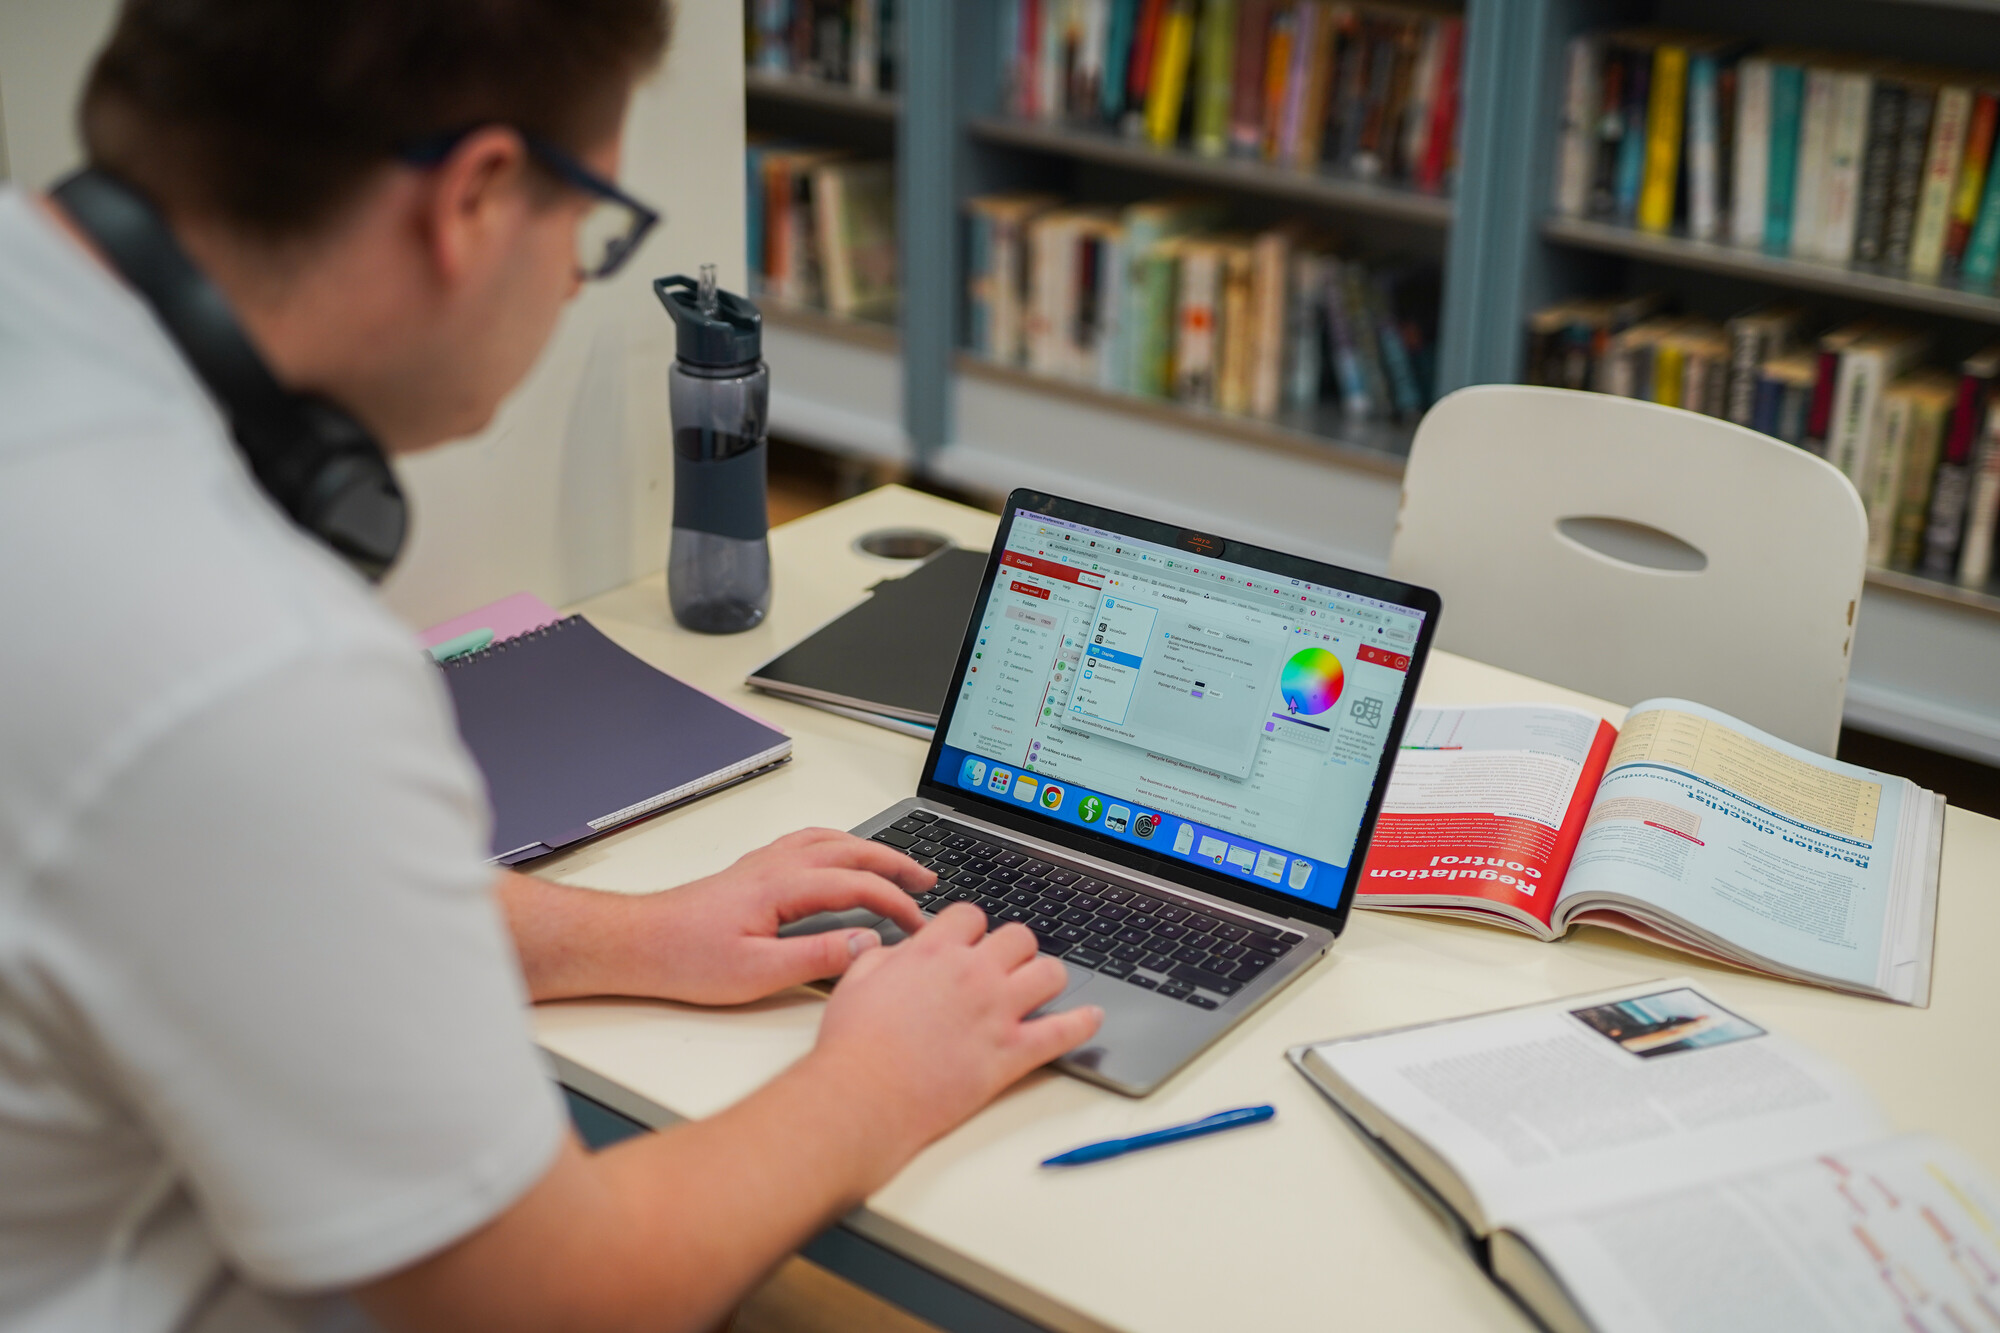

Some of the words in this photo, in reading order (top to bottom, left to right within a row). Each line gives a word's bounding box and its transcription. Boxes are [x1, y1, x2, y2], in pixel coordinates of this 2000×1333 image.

[1016, 558, 1033, 567] Outlook
[1161, 592, 1188, 604] Accessibility
[1021, 599, 1037, 608] Folders
[1115, 603, 1132, 611] Overview
[1108, 627, 1127, 636] VoiceOver
[1100, 650, 1114, 658] Display
[1110, 666, 1125, 674] Content
[1094, 674, 1116, 684] Descriptions
[1081, 719, 1103, 729] Accessibility
[1060, 726, 1077, 736] Freecycle
[1077, 731, 1090, 739] Group
[1046, 734, 1063, 744] Yesterday
[1708, 783, 1723, 791] able
[1697, 790, 1718, 800] and
[1735, 795, 1758, 808] should
[1687, 791, 1774, 835] checklist
[1723, 801, 1787, 833] respiration
[1538, 819, 1556, 828] Exam
[1774, 814, 1801, 827] chapter
[1792, 832, 1869, 861] Metabolism,
[1782, 835, 1868, 869] Revision
[1430, 856, 1541, 878] control
[1370, 870, 1536, 896] Regulation
